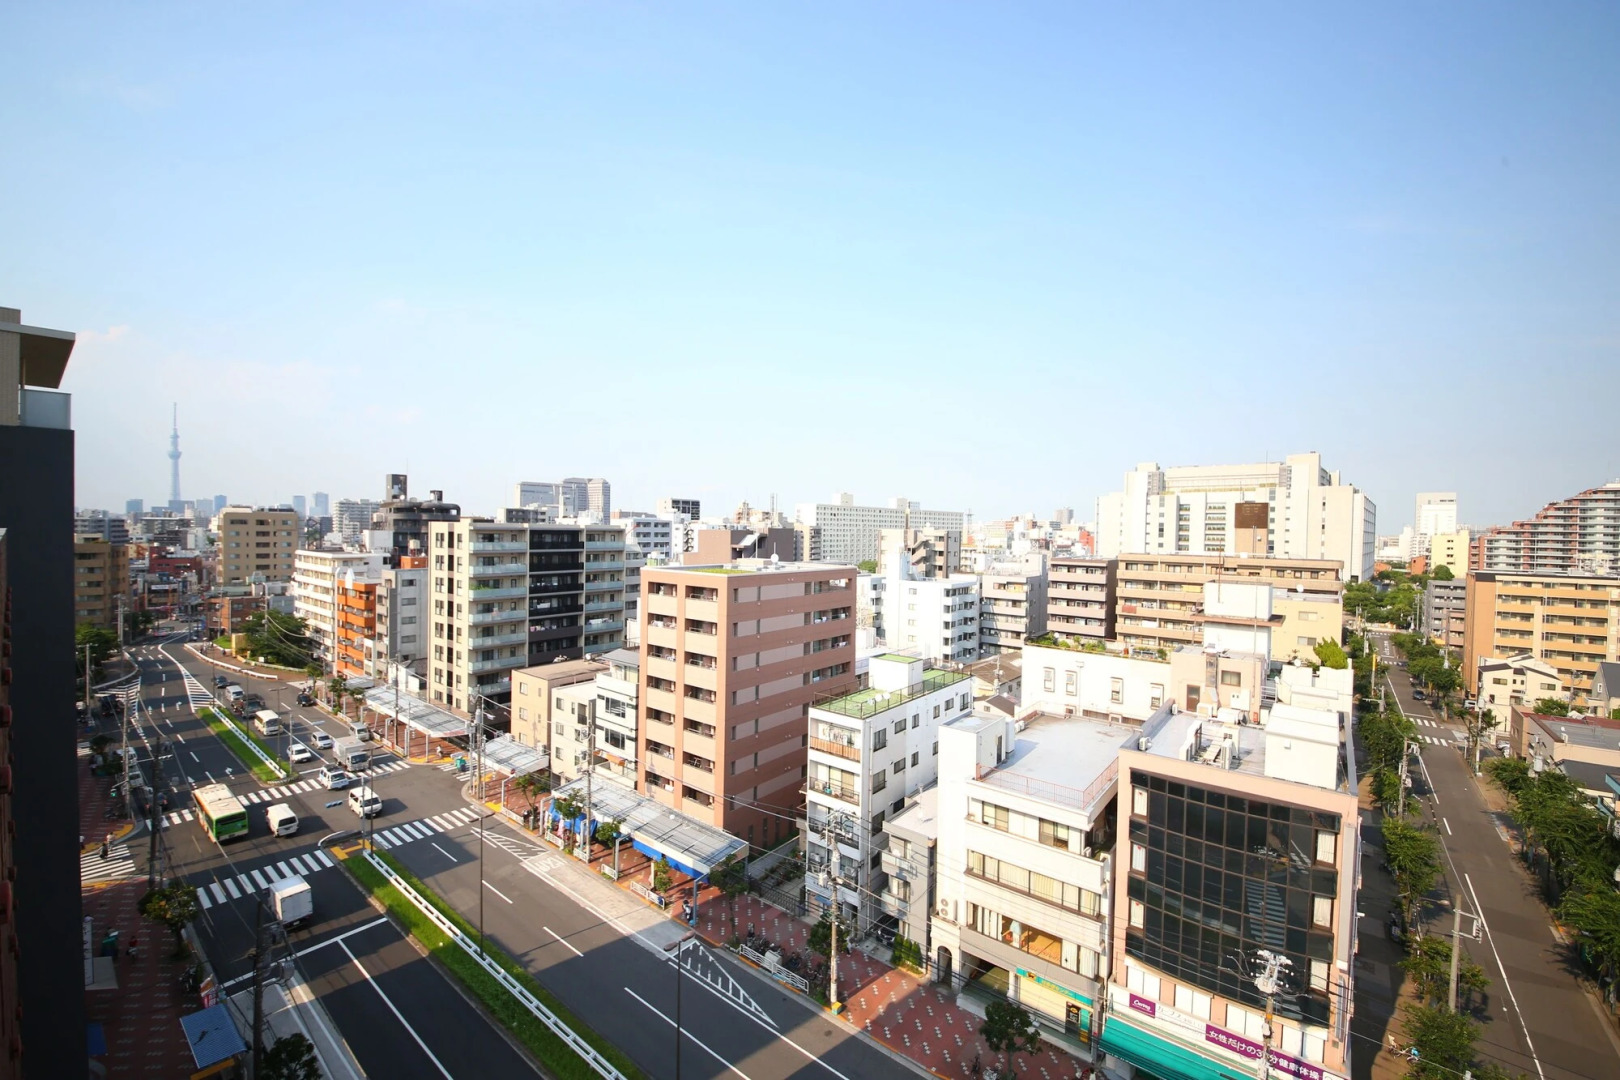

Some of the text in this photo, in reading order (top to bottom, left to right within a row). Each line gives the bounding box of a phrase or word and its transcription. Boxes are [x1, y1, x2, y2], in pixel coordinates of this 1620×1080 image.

[1209, 1030, 1320, 1080] 女性だけの3分健康体操
